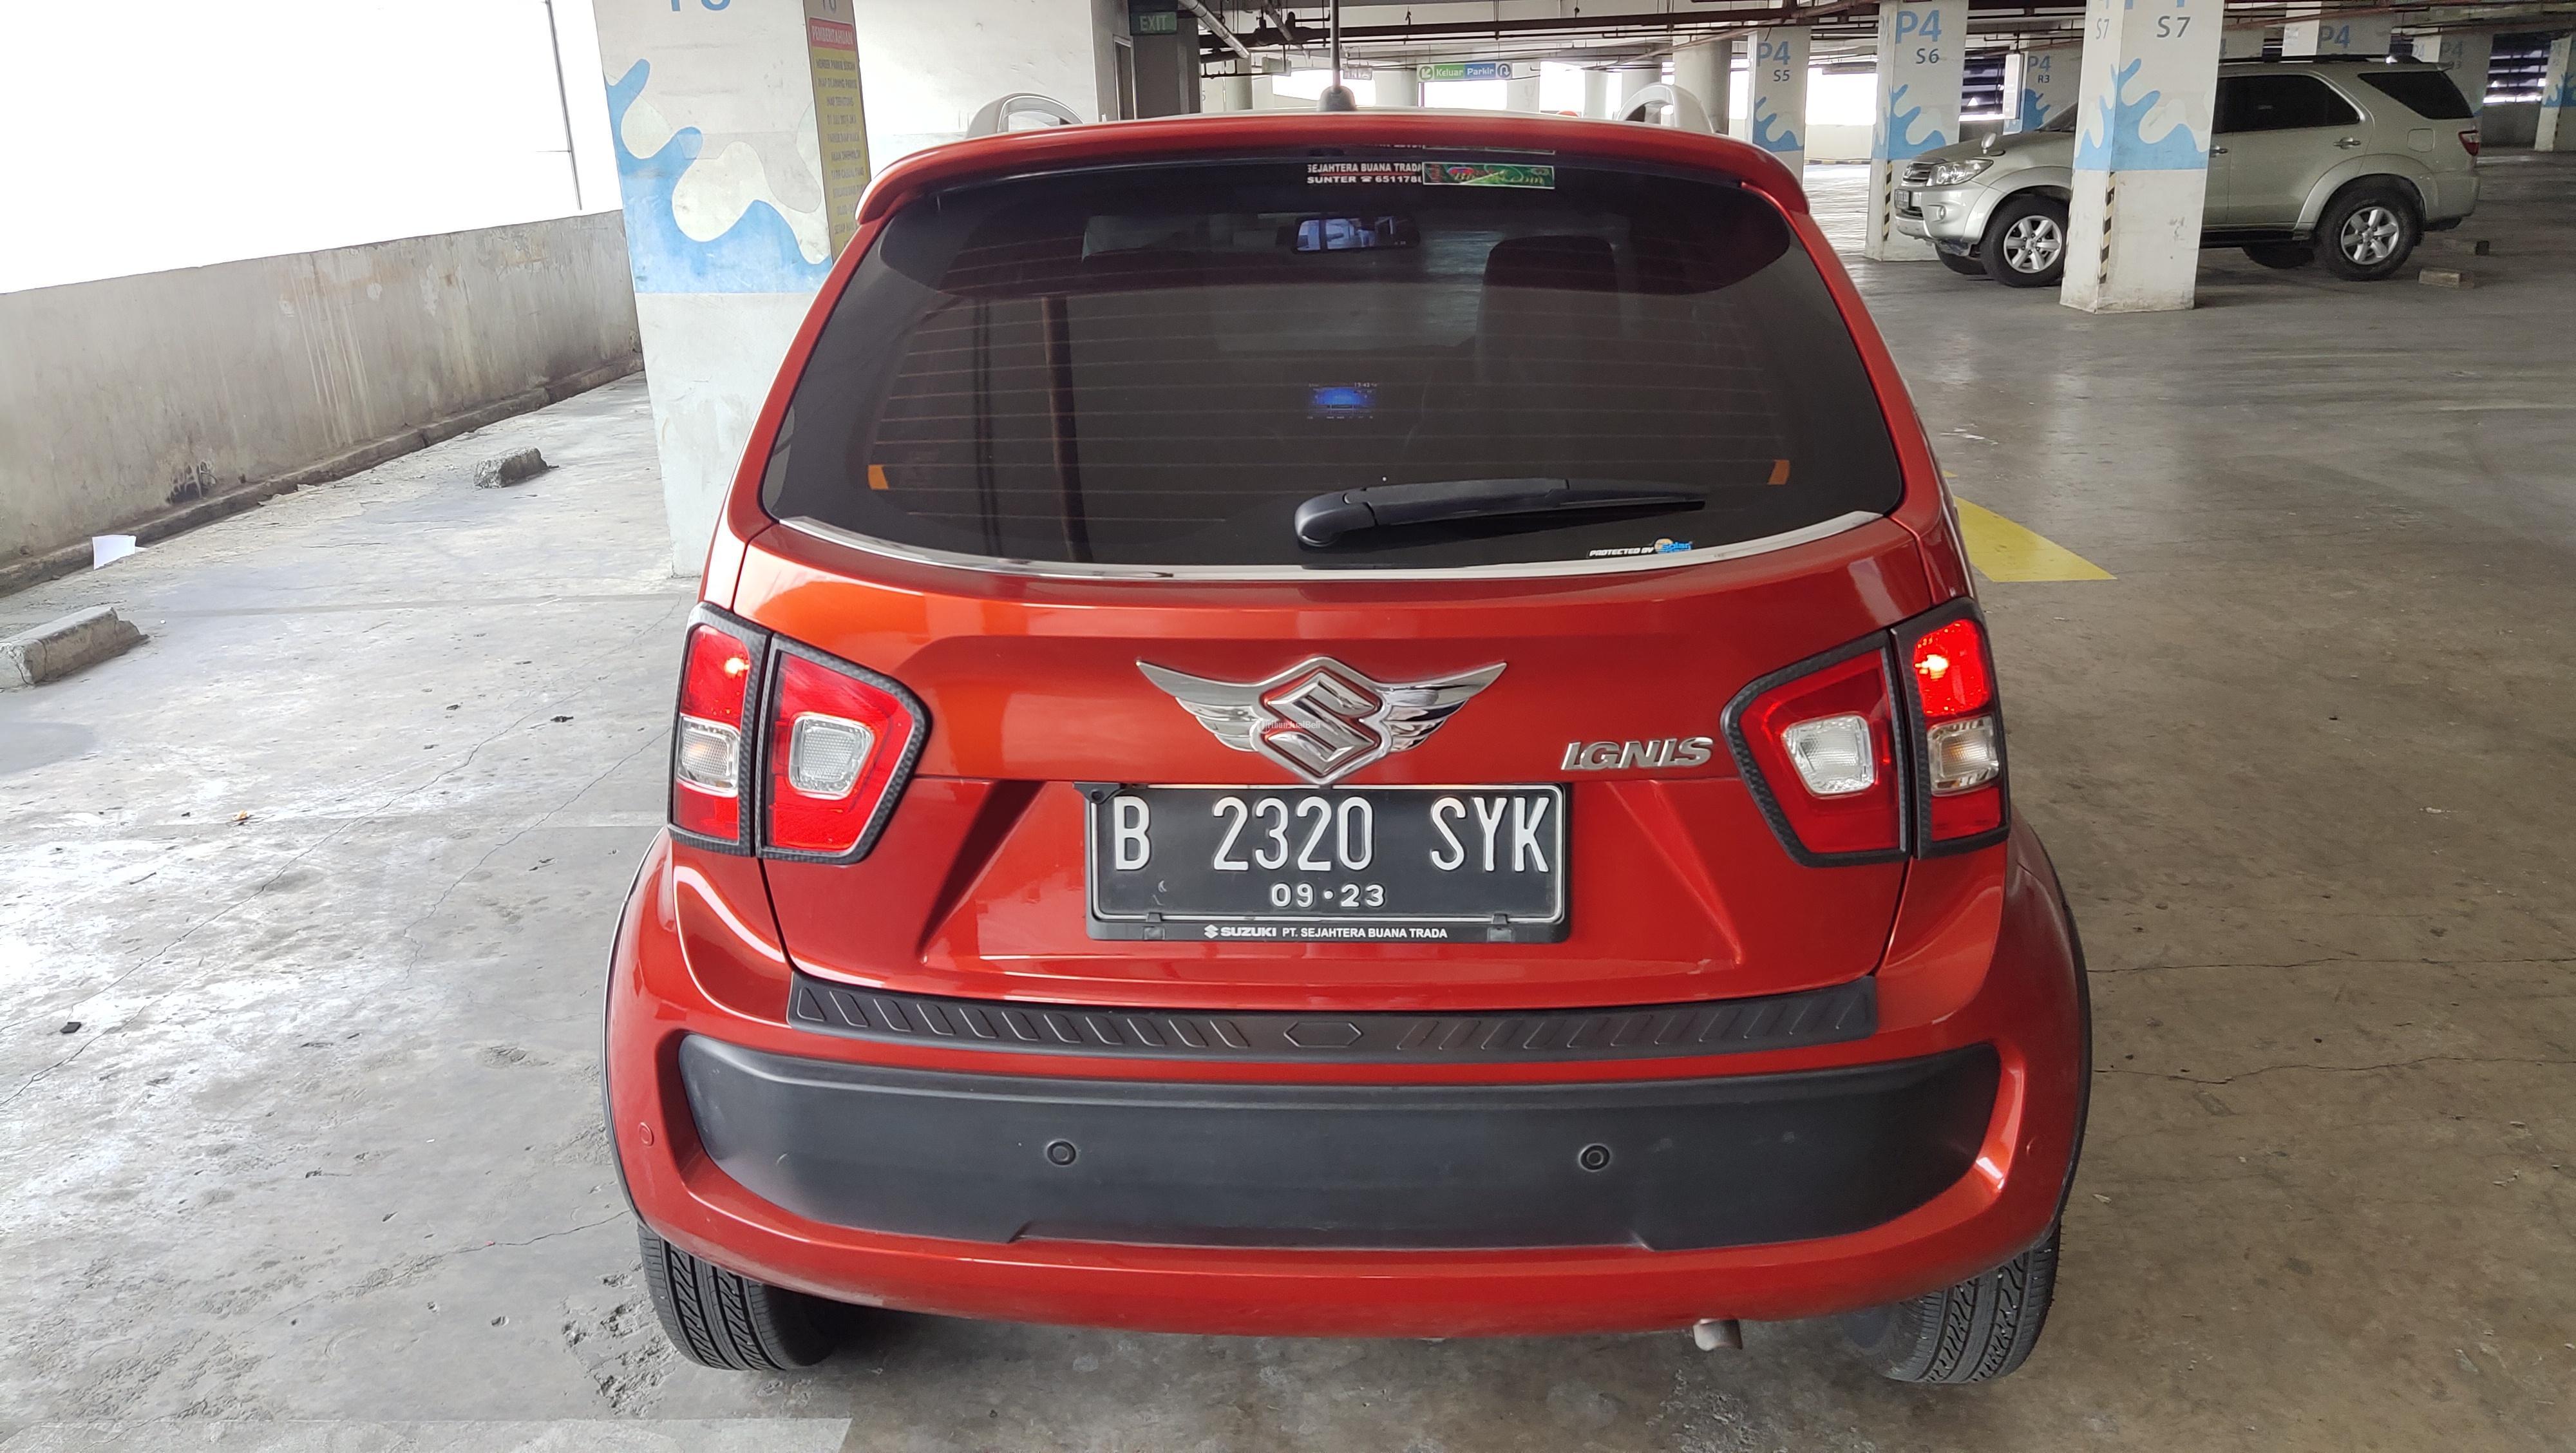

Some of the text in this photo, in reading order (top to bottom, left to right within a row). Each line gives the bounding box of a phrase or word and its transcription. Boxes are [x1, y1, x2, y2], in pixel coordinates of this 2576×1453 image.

[1139, 15, 1166, 32] EXIT
[1895, 10, 1942, 44] P4
[2096, 17, 2110, 40] S7
[2157, 15, 2191, 38] S7
[2318, 24, 2350, 49] P4
[1756, 41, 1790, 67] P4
[1916, 48, 1939, 64] S6
[1436, 67, 1494, 77] Keluar Parkir
[2027, 55, 2051, 72] P4
[1773, 70, 1790, 82] S5
[2038, 74, 2050, 83] R3
[1361, 163, 1392, 173] BUANA
[1307, 176, 1357, 184] SUNTER
[1589, 547, 1640, 556] PROTECTED
[1560, 736, 1714, 771] IGNIS
[1113, 795, 1550, 873] B 2320 SYK
[1220, 927, 1448, 938] SUZUKI PT. SEJAHTERA BUANA TRADA
